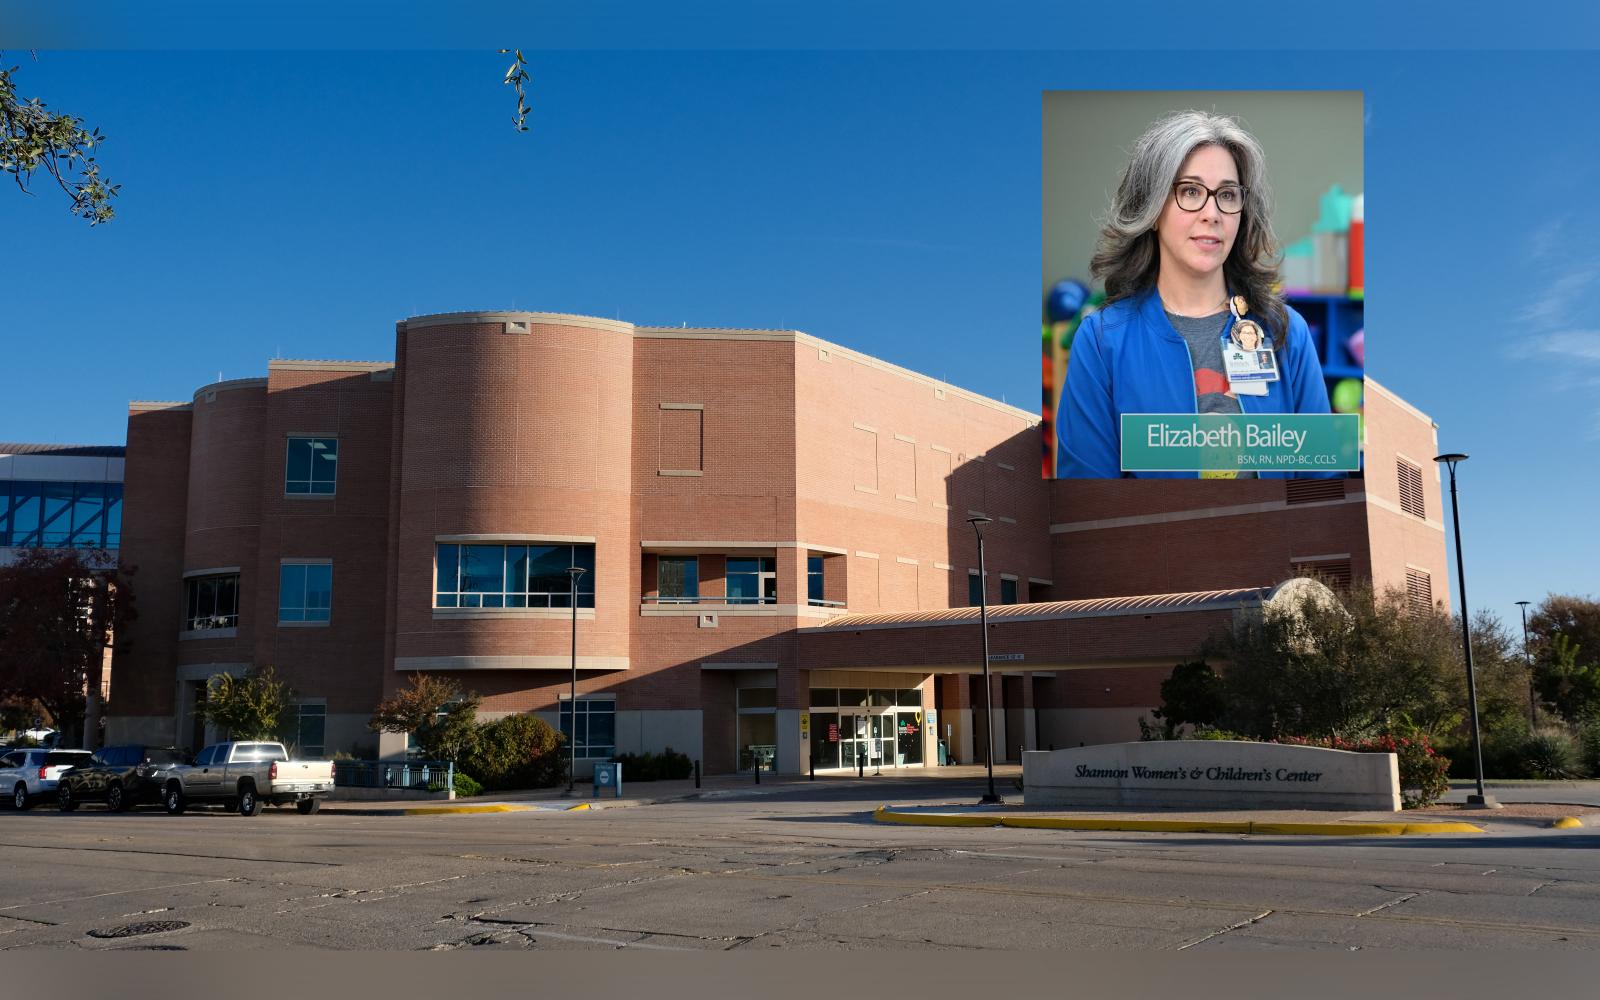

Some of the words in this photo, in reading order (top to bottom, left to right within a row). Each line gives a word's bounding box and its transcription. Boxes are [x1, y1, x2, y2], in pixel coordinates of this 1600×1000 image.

[1075, 764, 1129, 779] Shannon
[1131, 766, 1187, 780] Women's
[1190, 766, 1204, 780] &
[1206, 766, 1272, 781] Children's
[1275, 768, 1323, 782] Center
